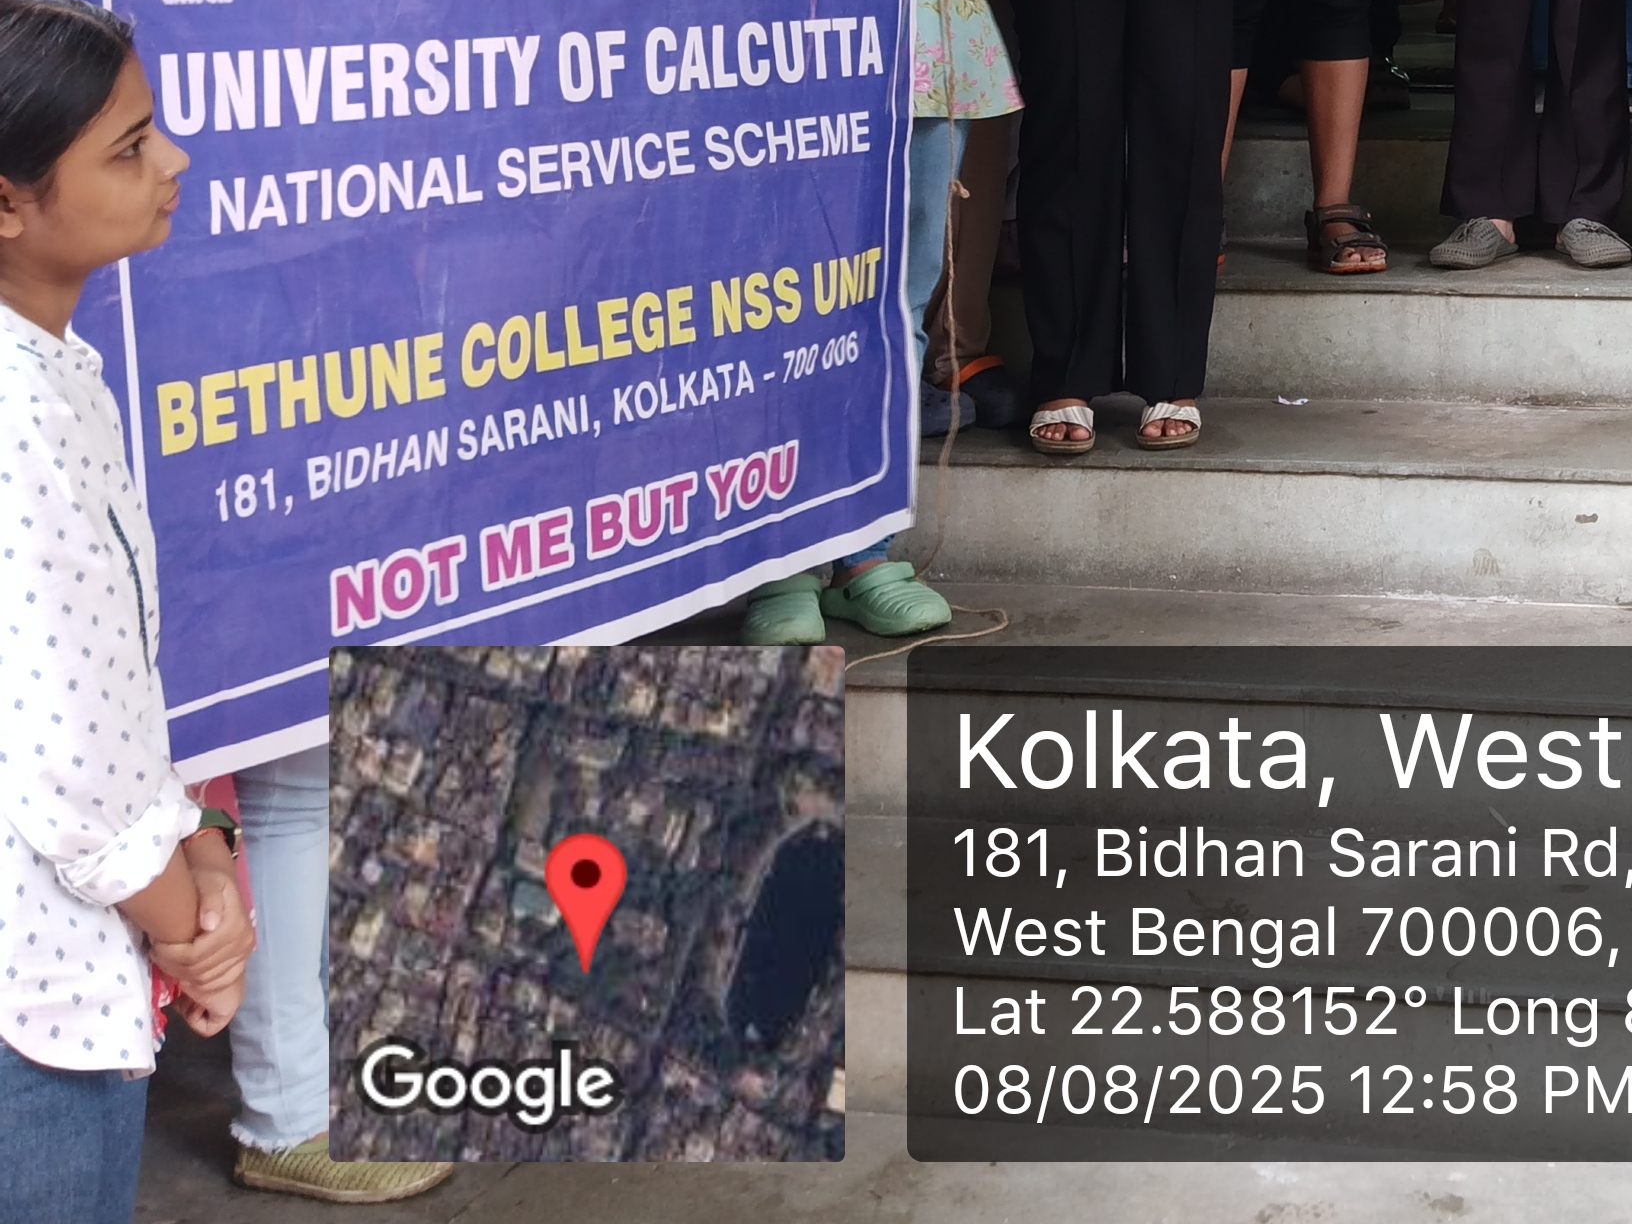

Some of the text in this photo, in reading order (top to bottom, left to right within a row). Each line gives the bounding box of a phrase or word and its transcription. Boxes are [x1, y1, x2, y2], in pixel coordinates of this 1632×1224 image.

[160, 16, 884, 136] UNIVERSITY OF CALCUTTA
[210, 110, 870, 235] NATIONAL SERVICE SCHEME
[159, 246, 883, 457] BETHUNE COLLEGE NSS UNIT
[215, 473, 293, 523] 181,
[309, 427, 449, 501] BIDHAN
[457, 395, 602, 461] SARANI,
[613, 360, 755, 426] KOLKATA
[781, 346, 817, 386] 700
[821, 330, 859, 371] 006
[334, 440, 799, 631] NOT ME BUT YOU
